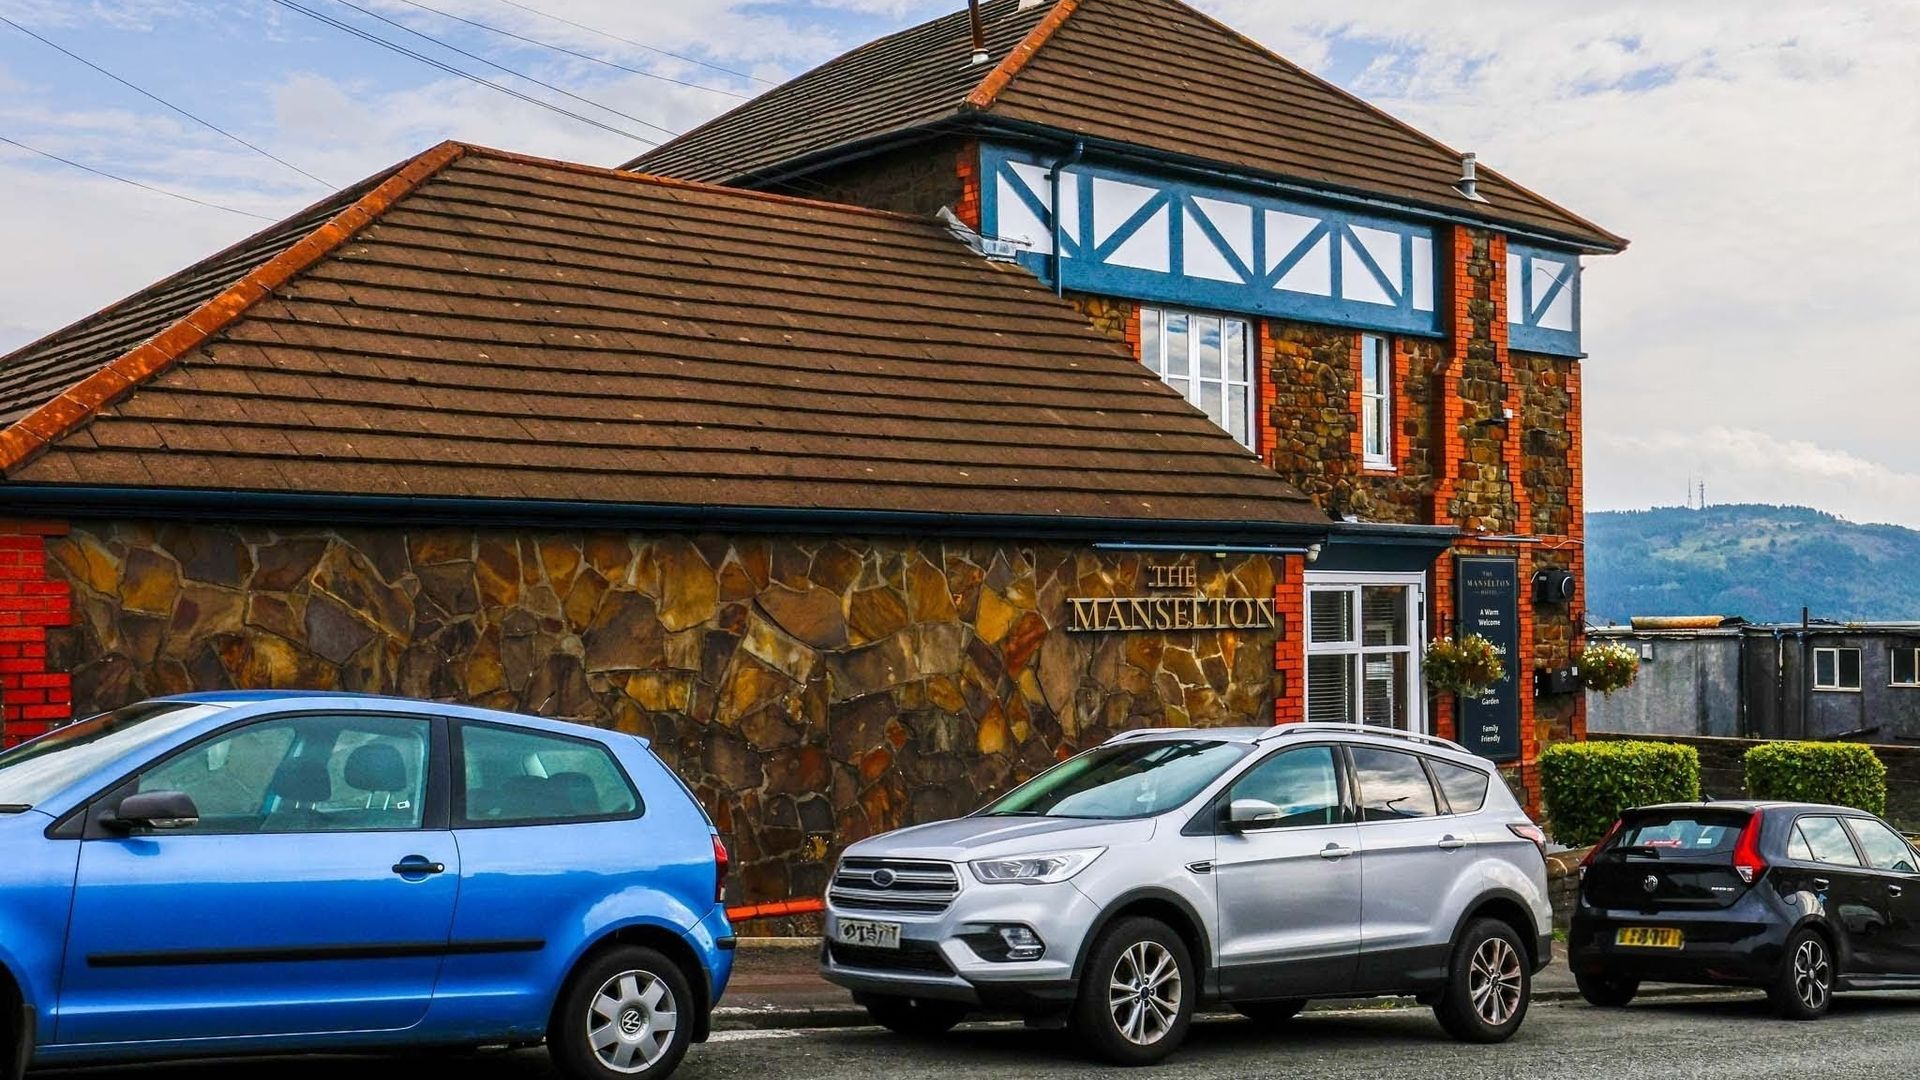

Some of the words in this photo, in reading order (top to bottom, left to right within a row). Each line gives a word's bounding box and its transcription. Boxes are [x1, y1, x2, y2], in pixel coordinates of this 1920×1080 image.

[1150, 565, 1197, 587] THE
[1071, 597, 1276, 631] MANSELTON
[1482, 725, 1498, 733] Family
[1481, 735, 1500, 743] Friendly
